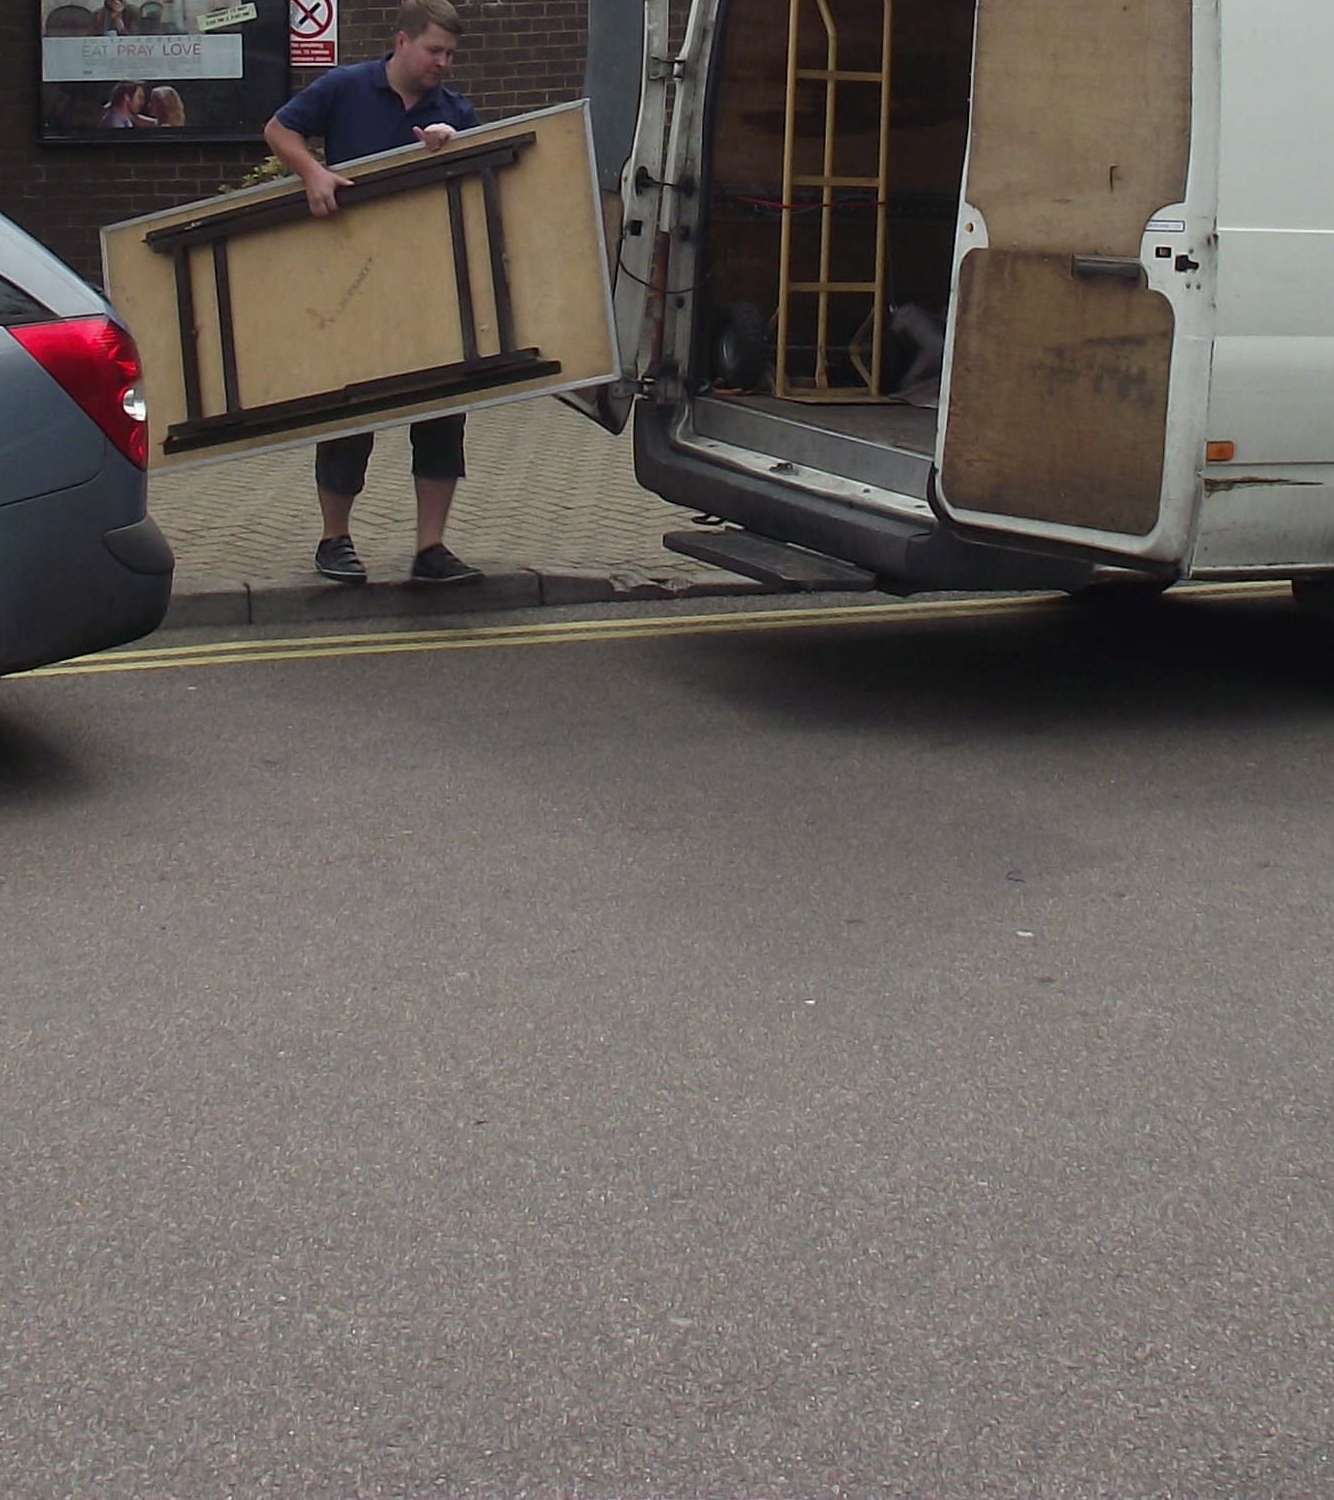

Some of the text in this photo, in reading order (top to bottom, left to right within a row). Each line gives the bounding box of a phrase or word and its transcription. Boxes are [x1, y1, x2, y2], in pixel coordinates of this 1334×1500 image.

[82, 42, 201, 58] EAT PRAY LOVE
